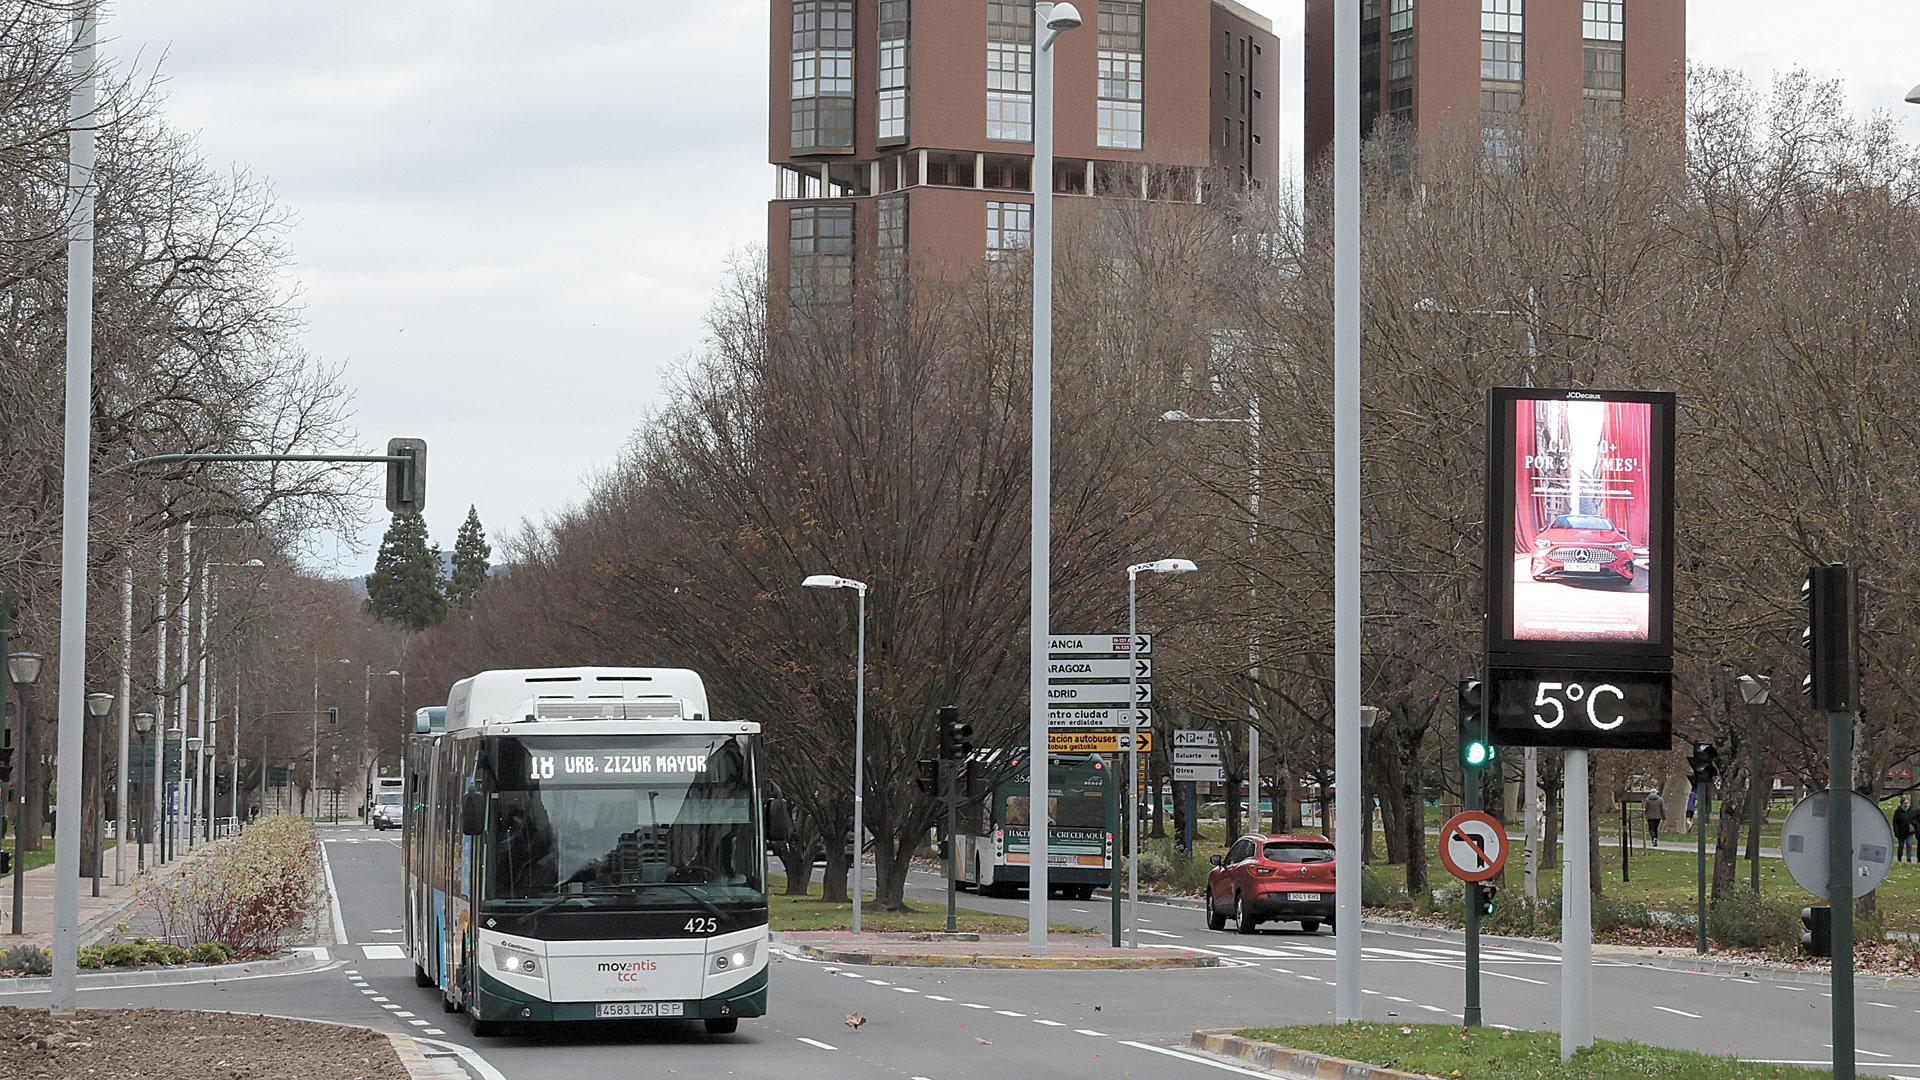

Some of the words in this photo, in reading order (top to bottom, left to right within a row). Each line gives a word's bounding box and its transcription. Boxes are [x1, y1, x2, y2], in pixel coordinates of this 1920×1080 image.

[1566, 391, 1601, 399] JCDecaux
[1525, 455, 1556, 470] POR
[1048, 690, 1077, 698] ADRID
[1535, 682, 1623, 730] 5°C
[1074, 710, 1108, 719] ciudad
[1074, 735, 1117, 743] autobuses
[564, 756, 599, 773] URB.
[603, 756, 651, 773] ZIZUR
[656, 755, 707, 773] MAYOR
[684, 917, 717, 932] 425
[598, 959, 656, 971] moventis
[618, 971, 637, 981] tcc
[603, 1005, 630, 1015] 4583
[633, 1004, 654, 1015] LZR
